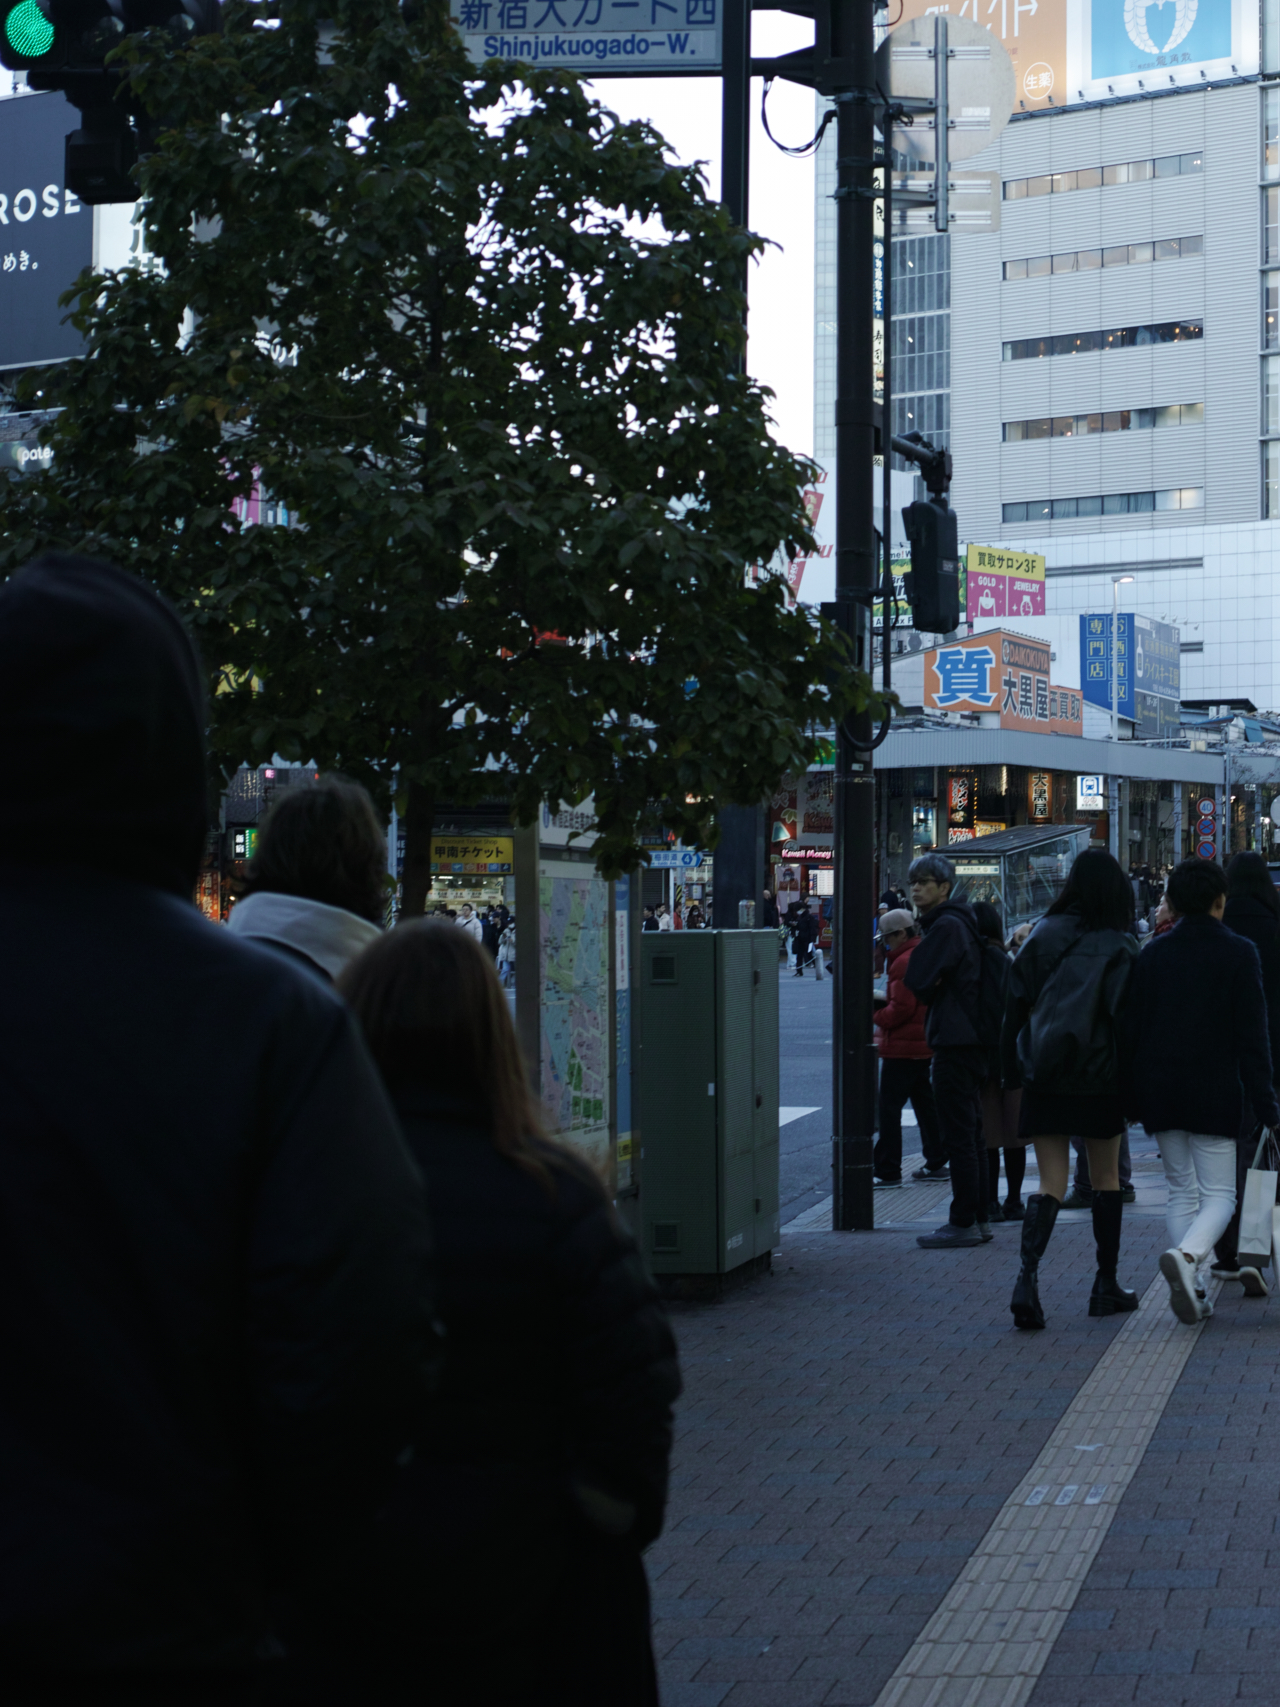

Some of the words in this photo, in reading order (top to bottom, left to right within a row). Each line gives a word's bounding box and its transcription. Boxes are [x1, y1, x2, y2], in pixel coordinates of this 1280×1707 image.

[1026, 72, 1052, 91] 生薬
[977, 551, 1037, 575] 買取サロン3F
[977, 576, 997, 588] GOLD
[1013, 581, 1041, 594] JEWELRY
[1009, 644, 1050, 672] DAIKOKUYA
[1089, 618, 1104, 678] 専門店
[931, 645, 999, 708] 質
[1001, 667, 1050, 722] 大黒屋
[1032, 773, 1048, 817] 大黒屋
[1201, 803, 1212, 811] 40
[434, 846, 504, 859] 甲南チケット
[651, 853, 678, 861] 梅街道
[684, 855, 691, 864] 4
[781, 849, 806, 859] Kawaii
[806, 849, 833, 860] Money
